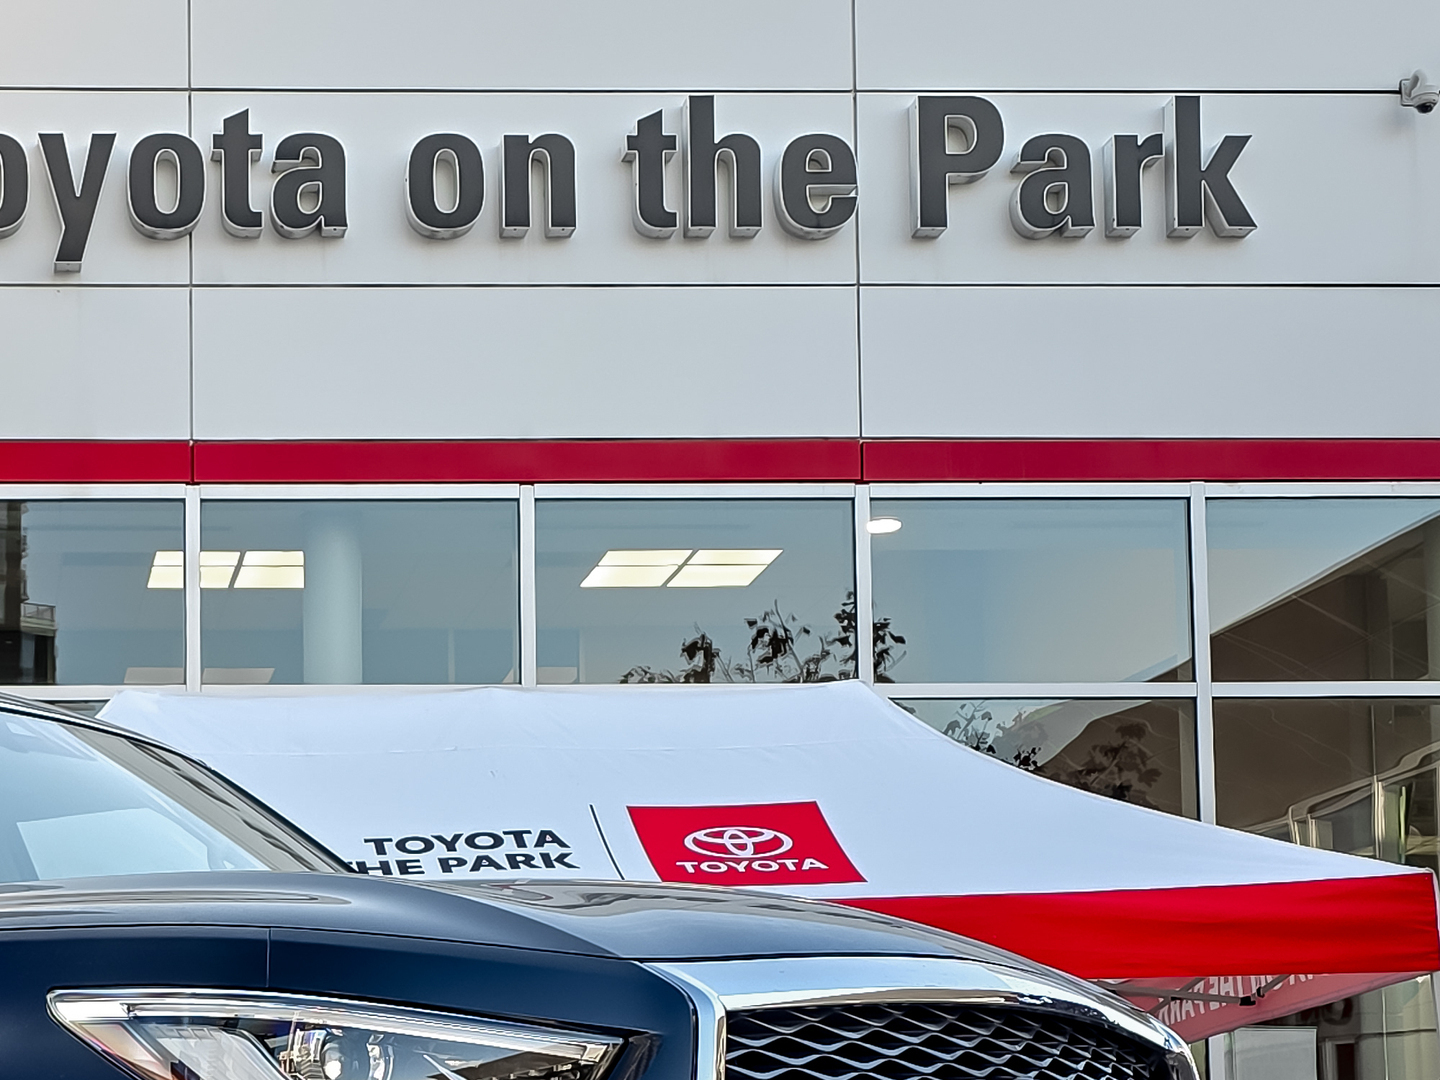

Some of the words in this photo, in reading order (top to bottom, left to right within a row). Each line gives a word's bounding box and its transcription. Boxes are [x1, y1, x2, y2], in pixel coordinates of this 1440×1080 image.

[405, 132, 576, 240] on
[621, 95, 859, 240] the
[910, 95, 1258, 240] Park
[363, 829, 572, 856] TOYOTA
[437, 852, 580, 874] PARK
[676, 858, 830, 873] TOYOTA
